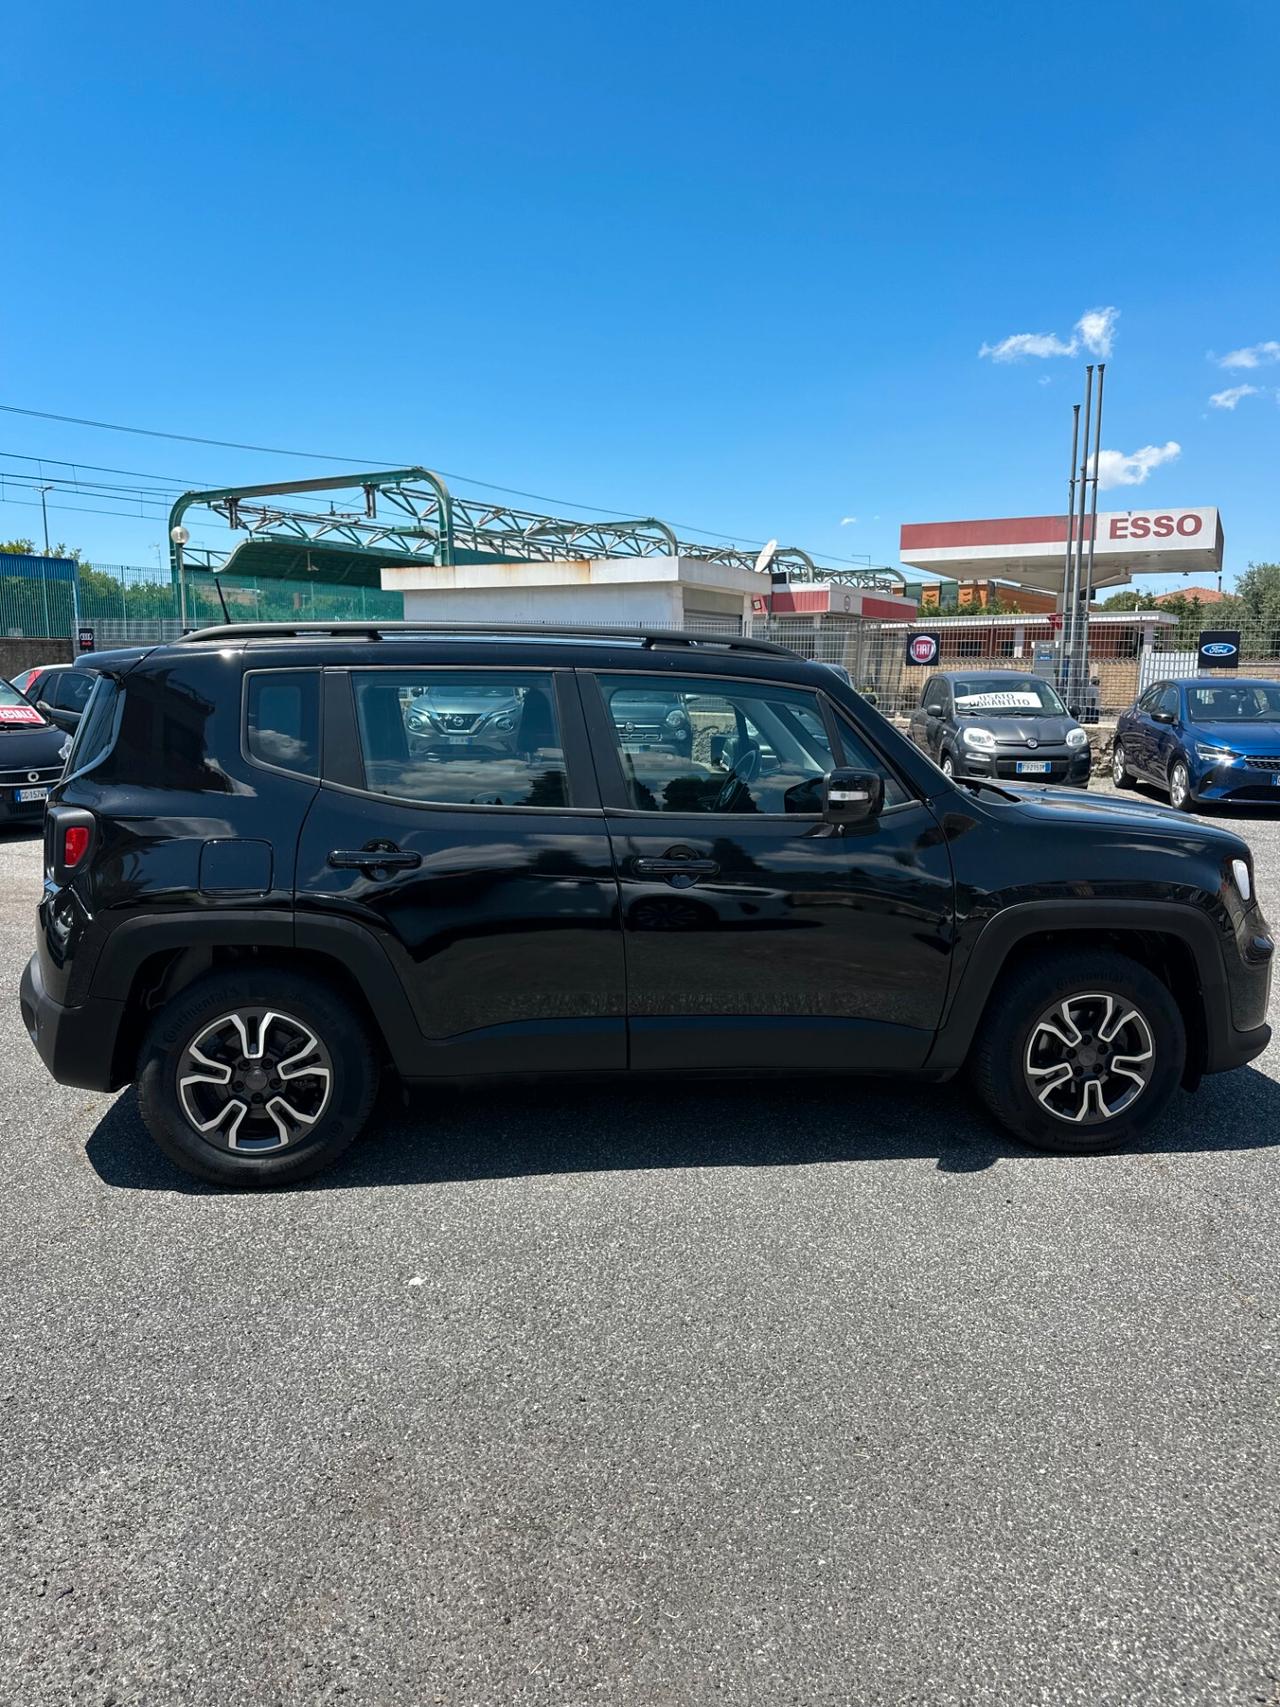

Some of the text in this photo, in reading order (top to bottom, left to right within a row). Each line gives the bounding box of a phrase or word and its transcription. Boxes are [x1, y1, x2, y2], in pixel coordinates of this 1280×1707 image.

[1109, 514, 1203, 539] ESSO
[916, 643, 931, 655] FIAT
[1208, 645, 1229, 654] Ford
[979, 693, 1014, 701] USATO
